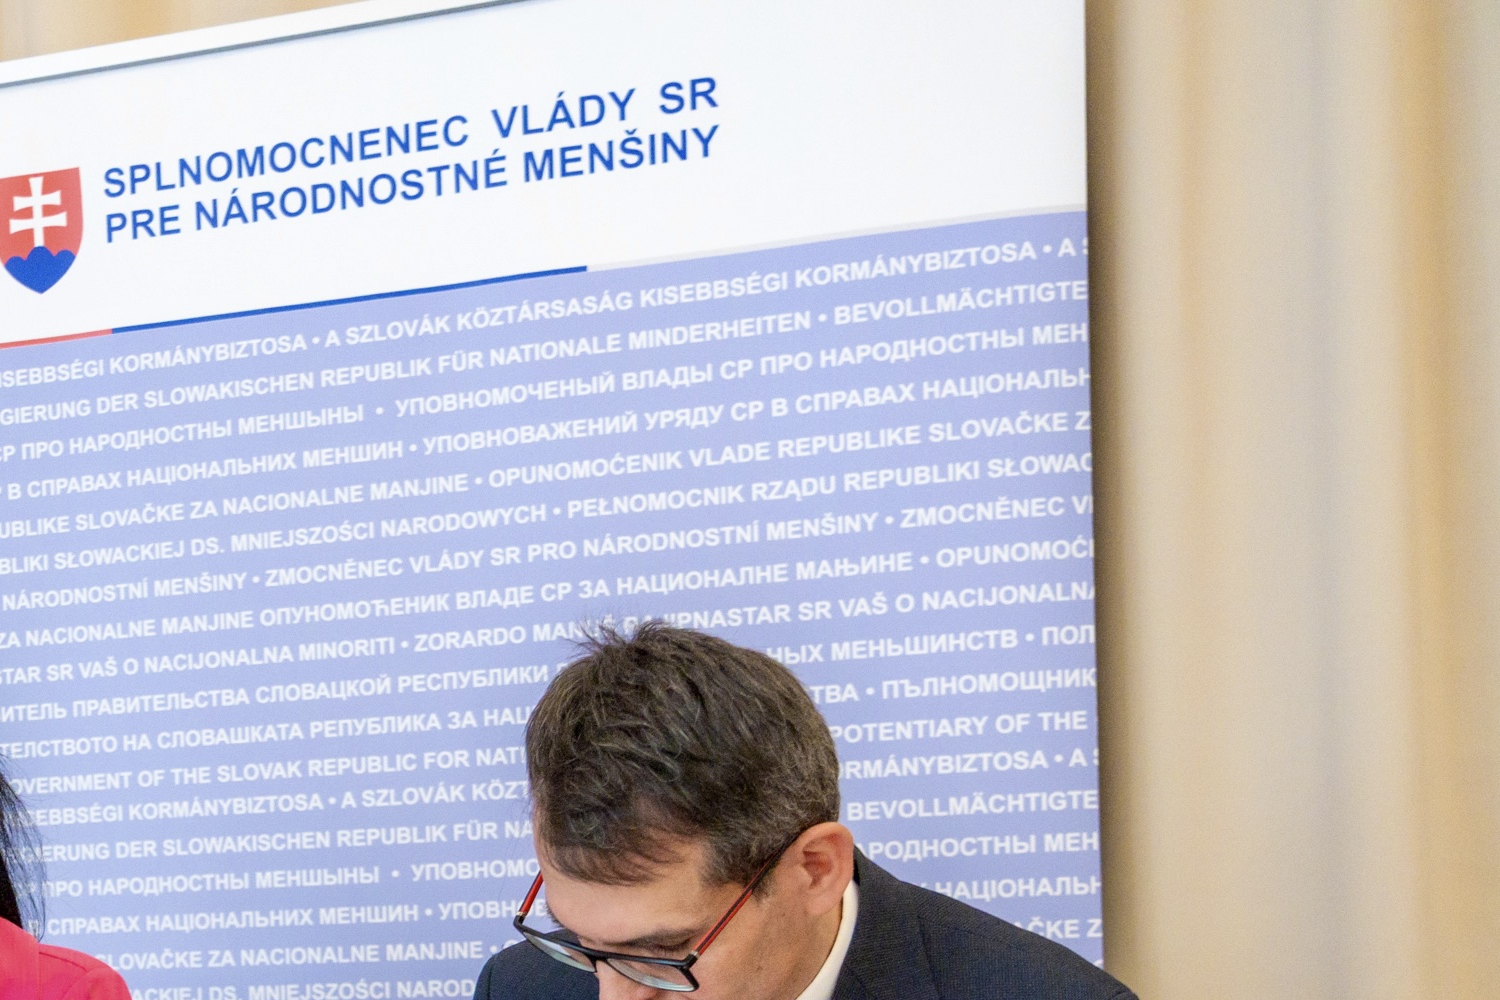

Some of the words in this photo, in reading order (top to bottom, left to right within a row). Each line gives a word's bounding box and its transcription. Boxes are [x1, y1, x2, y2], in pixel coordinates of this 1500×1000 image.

[104, 115, 468, 198] SPLNOMOCNENEC
[490, 87, 635, 138] VLÁDY
[659, 76, 718, 114] SR
[105, 204, 181, 243] PRE
[195, 148, 507, 230] NÁRODNOSTNÉ
[523, 124, 719, 182] MENŠINY
[109, 334, 307, 374] KORMÁNYBIZTOSA
[322, 329, 340, 347] A
[345, 313, 450, 345] SZLOVÁK
[457, 289, 633, 330] KÖZTÁRSASÁG
[640, 271, 788, 307] KISEBBSÉGI
[795, 241, 1037, 288] KORMÁNYBIZTOSA
[1054, 237, 1076, 257] A
[21, 439, 64, 460] ПРО
[69, 419, 232, 454] НАРОДНОСТНЫ
[238, 404, 364, 434] МЕНШЫНЫ
[395, 371, 615, 417] УПОВНОМОЧЕНЫЙ
[622, 363, 713, 391] ВЛАДЫ
[719, 359, 753, 380] СР
[760, 351, 813, 375] ПРО
[820, 327, 1024, 368] НАРОДНОСТНЫ
[1032, 322, 1088, 345] МЕН
[96, 392, 138, 414] DER
[144, 371, 314, 408] SLOWAKISCHEN
[320, 357, 431, 387] REPUBLIK
[438, 349, 483, 373] FÜR
[490, 333, 621, 366] NATIONALE
[628, 310, 811, 350] MINDERHEITEN
[7, 482, 22, 500] В
[26, 471, 121, 498] СПРАВАХ
[127, 451, 297, 487] НАЦІОНАЛЬНИХ
[302, 440, 403, 467] МЕНШИН
[422, 410, 637, 455] УПОВНОВАЖЕНИЙ
[644, 404, 724, 430] УРЯДУ
[730, 400, 764, 421] СР
[771, 397, 788, 417] В
[795, 382, 916, 414] СПРАВАХ
[75, 502, 184, 531] SLOVAČKE
[190, 500, 218, 519] ZA
[223, 484, 364, 515] NACIONALNE
[370, 473, 468, 500] MANJINE
[488, 450, 682, 488] OPUNOMOĆENIK
[688, 441, 771, 467] VLADE
[777, 425, 921, 458] REPUBLIKE
[928, 410, 1068, 442] SLOVAČKE
[2, 577, 148, 611] NÁRODNOSTNÍ
[154, 572, 246, 596] MENŠINY
[265, 557, 403, 587] ZMOCNĚNEC
[408, 549, 484, 573] VLÁDY
[490, 546, 521, 566] SR
[527, 540, 577, 562] PRO
[583, 520, 759, 557] NÁRODNOSTNÍ
[766, 512, 878, 540] MENŠINY
[900, 496, 1065, 528] ZMOCNĚNEC
[53, 540, 184, 569] SŁOWACKIEJ
[190, 536, 224, 556] DS.
[230, 520, 374, 552] MNIEJSZOŚCI
[381, 503, 546, 537] NARODOWYCH
[567, 484, 745, 518] PEŁNOMOCNIK
[751, 475, 836, 501] RZĄDU
[844, 460, 980, 492] REPUBLIKI
[25, 619, 156, 646] NACIONALNE
[161, 610, 254, 634] MANJINE
[259, 593, 449, 626] ОПУНОМОЋЕНИК
[455, 585, 534, 610] ВЛАДЕ
[540, 582, 572, 601] СР
[578, 578, 610, 598] ЗА
[616, 563, 788, 595] НАЦИОНАЛНЕ
[796, 551, 913, 580] МАЊИНЕ
[46, 663, 74, 681] SR
[78, 656, 118, 678] VAŠ
[123, 658, 138, 675] O
[144, 645, 294, 673] NACIJONALNA
[298, 637, 395, 661] MINORITI
[414, 625, 526, 652] ZORARDO
[798, 600, 832, 621] SR
[838, 591, 888, 617] VAŠ
[895, 593, 915, 612] O
[72, 688, 250, 717] ПРАВИТЕЛЬСТВА
[255, 674, 391, 703] СЛОВАЦКОЙ
[398, 664, 549, 693] РЕСПУБЛИКИ
[831, 628, 1018, 660] МЕНЬШИНСТВ
[123, 733, 151, 751] НА
[157, 723, 304, 749] СЛОВАШКАТА
[309, 713, 442, 738] РЕПУБЛИКА
[447, 710, 477, 729] ЗА
[137, 769, 164, 787] OF
[170, 766, 211, 785] THE
[217, 760, 302, 782] SLOVAK
[308, 753, 417, 776] REPUBLIC
[423, 749, 470, 769] FOR
[995, 713, 1031, 734] OF
[1037, 710, 1087, 731] THE
[128, 793, 324, 820] KORMÁNYBIZTOSA
[341, 791, 357, 808] A
[361, 782, 465, 807] SZLOVÁK
[1068, 748, 1088, 767] A
[88, 872, 249, 896] НАРОДНОСТНЫ
[255, 866, 379, 888] МЕНШЫНЫ
[115, 840, 157, 858] DER
[163, 830, 330, 856] SLOWAKISCHEN
[336, 824, 447, 847] REPUBLIK
[453, 819, 498, 841] FÜR
[47, 915, 140, 934] СПРАВАХ
[145, 908, 313, 932] НАЦІОНАЛЬНИХ
[319, 904, 419, 924] МЕНШИН
[207, 950, 236, 967] ZA
[240, 944, 380, 966] NACIONALNE
[385, 940, 484, 961] MANJINE
